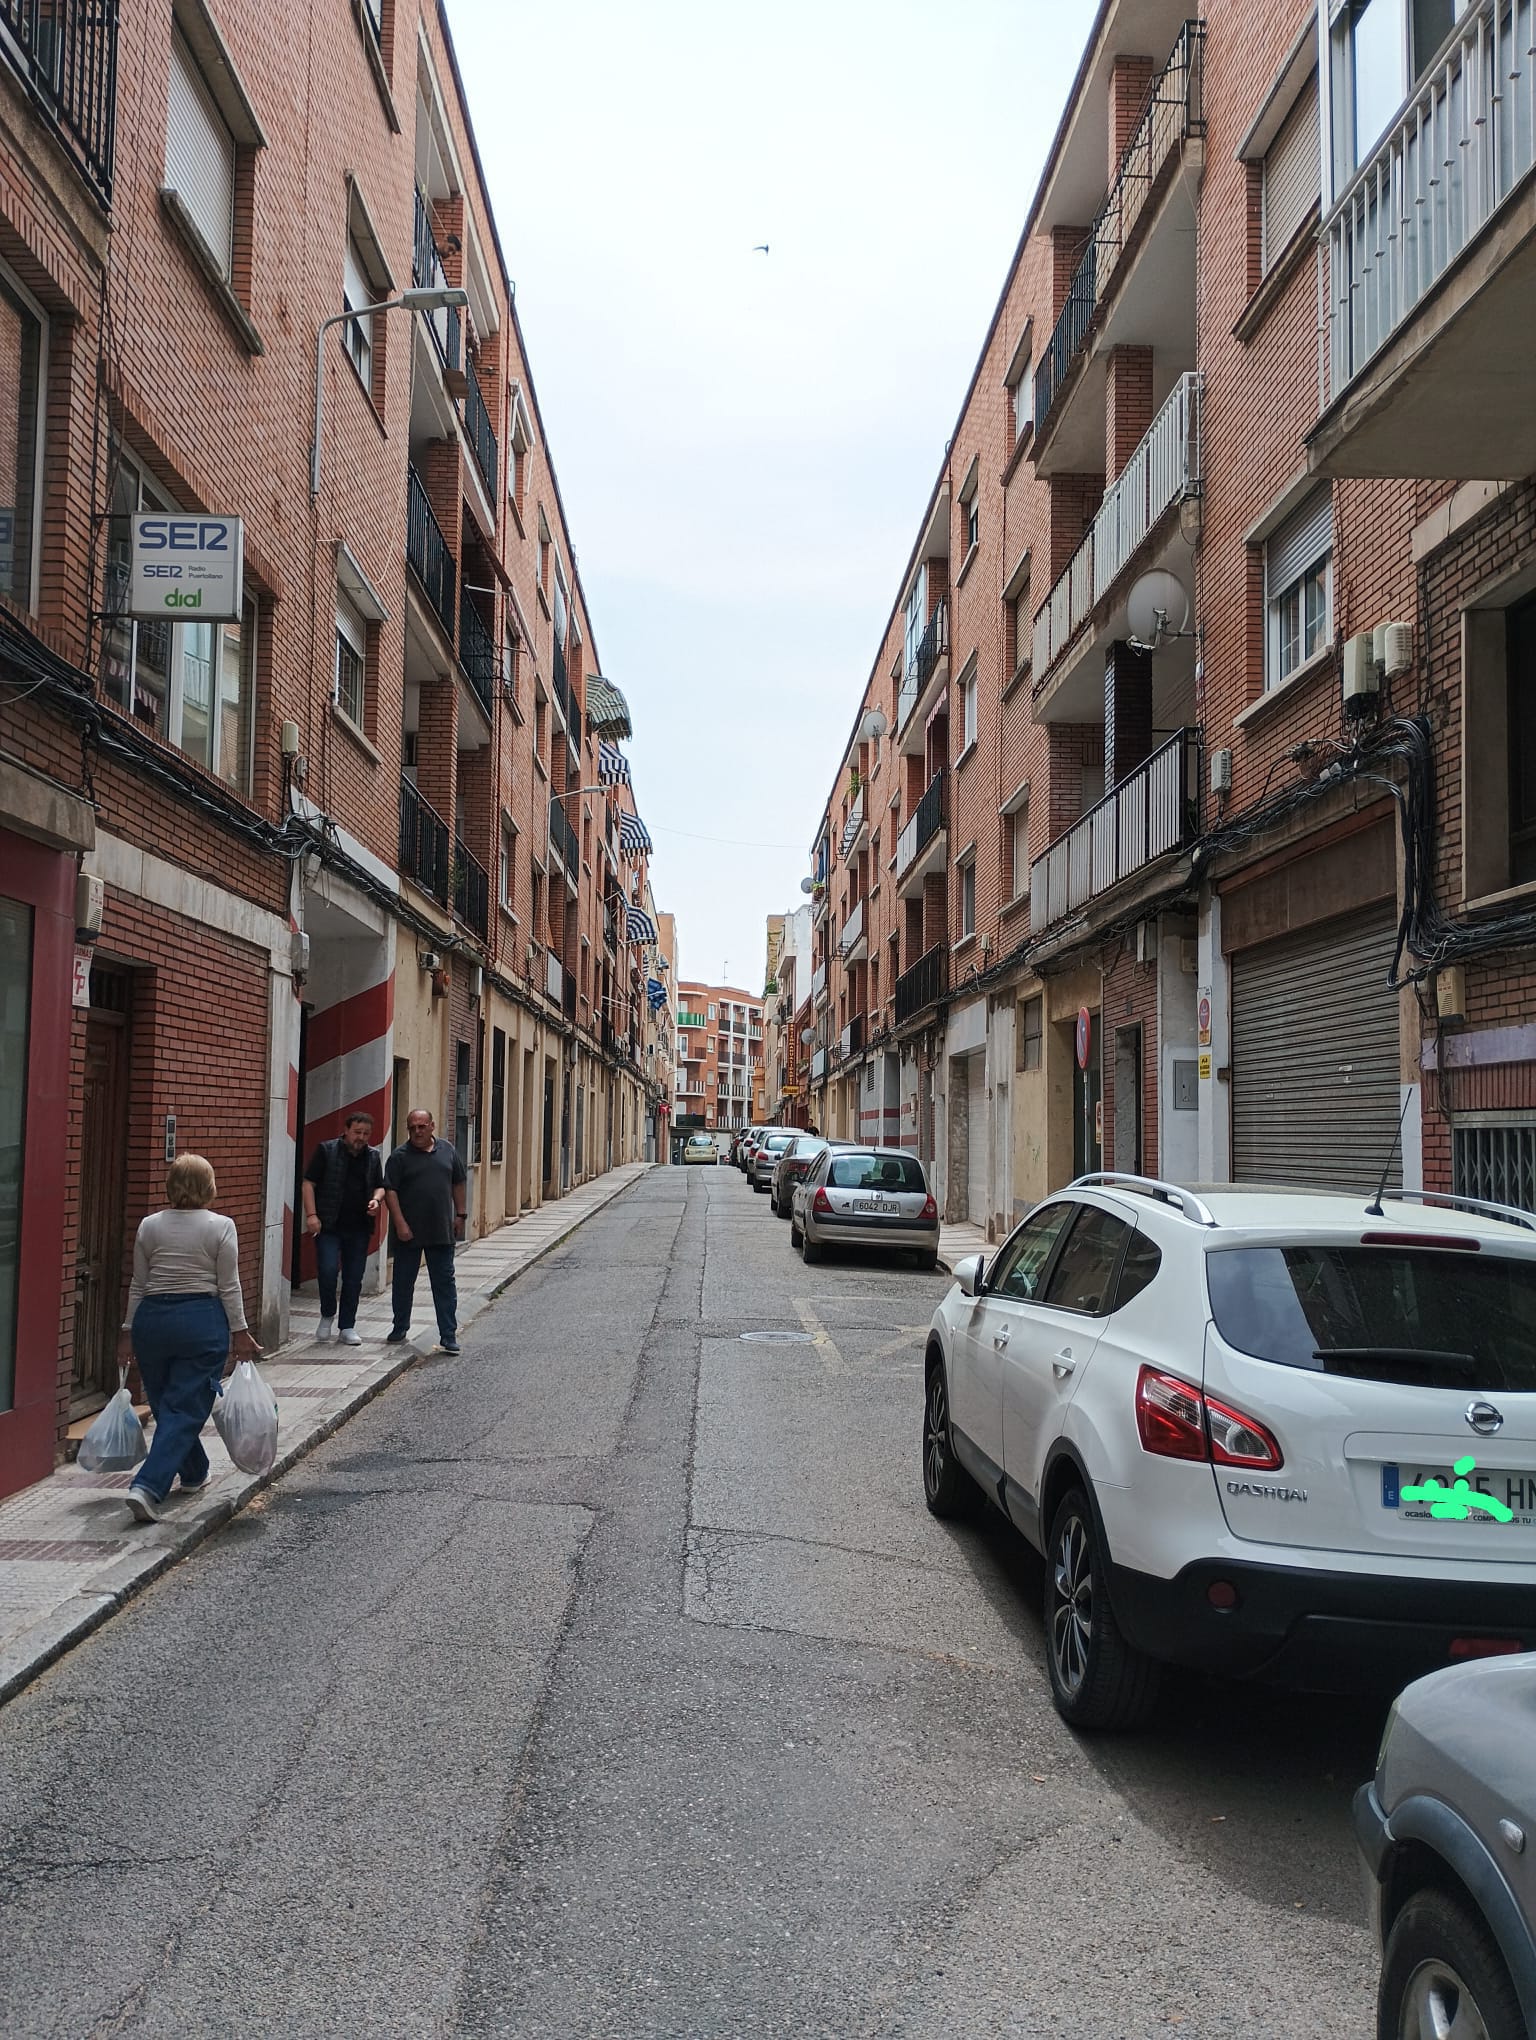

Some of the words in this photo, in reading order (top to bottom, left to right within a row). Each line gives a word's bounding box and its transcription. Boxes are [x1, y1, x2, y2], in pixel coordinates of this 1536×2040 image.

[139, 522, 228, 550] SER
[143, 565, 182, 578] SER
[164, 588, 202, 608] dial
[860, 1202, 879, 1211] 6042
[1226, 1481, 1308, 1503] QASHQAI
